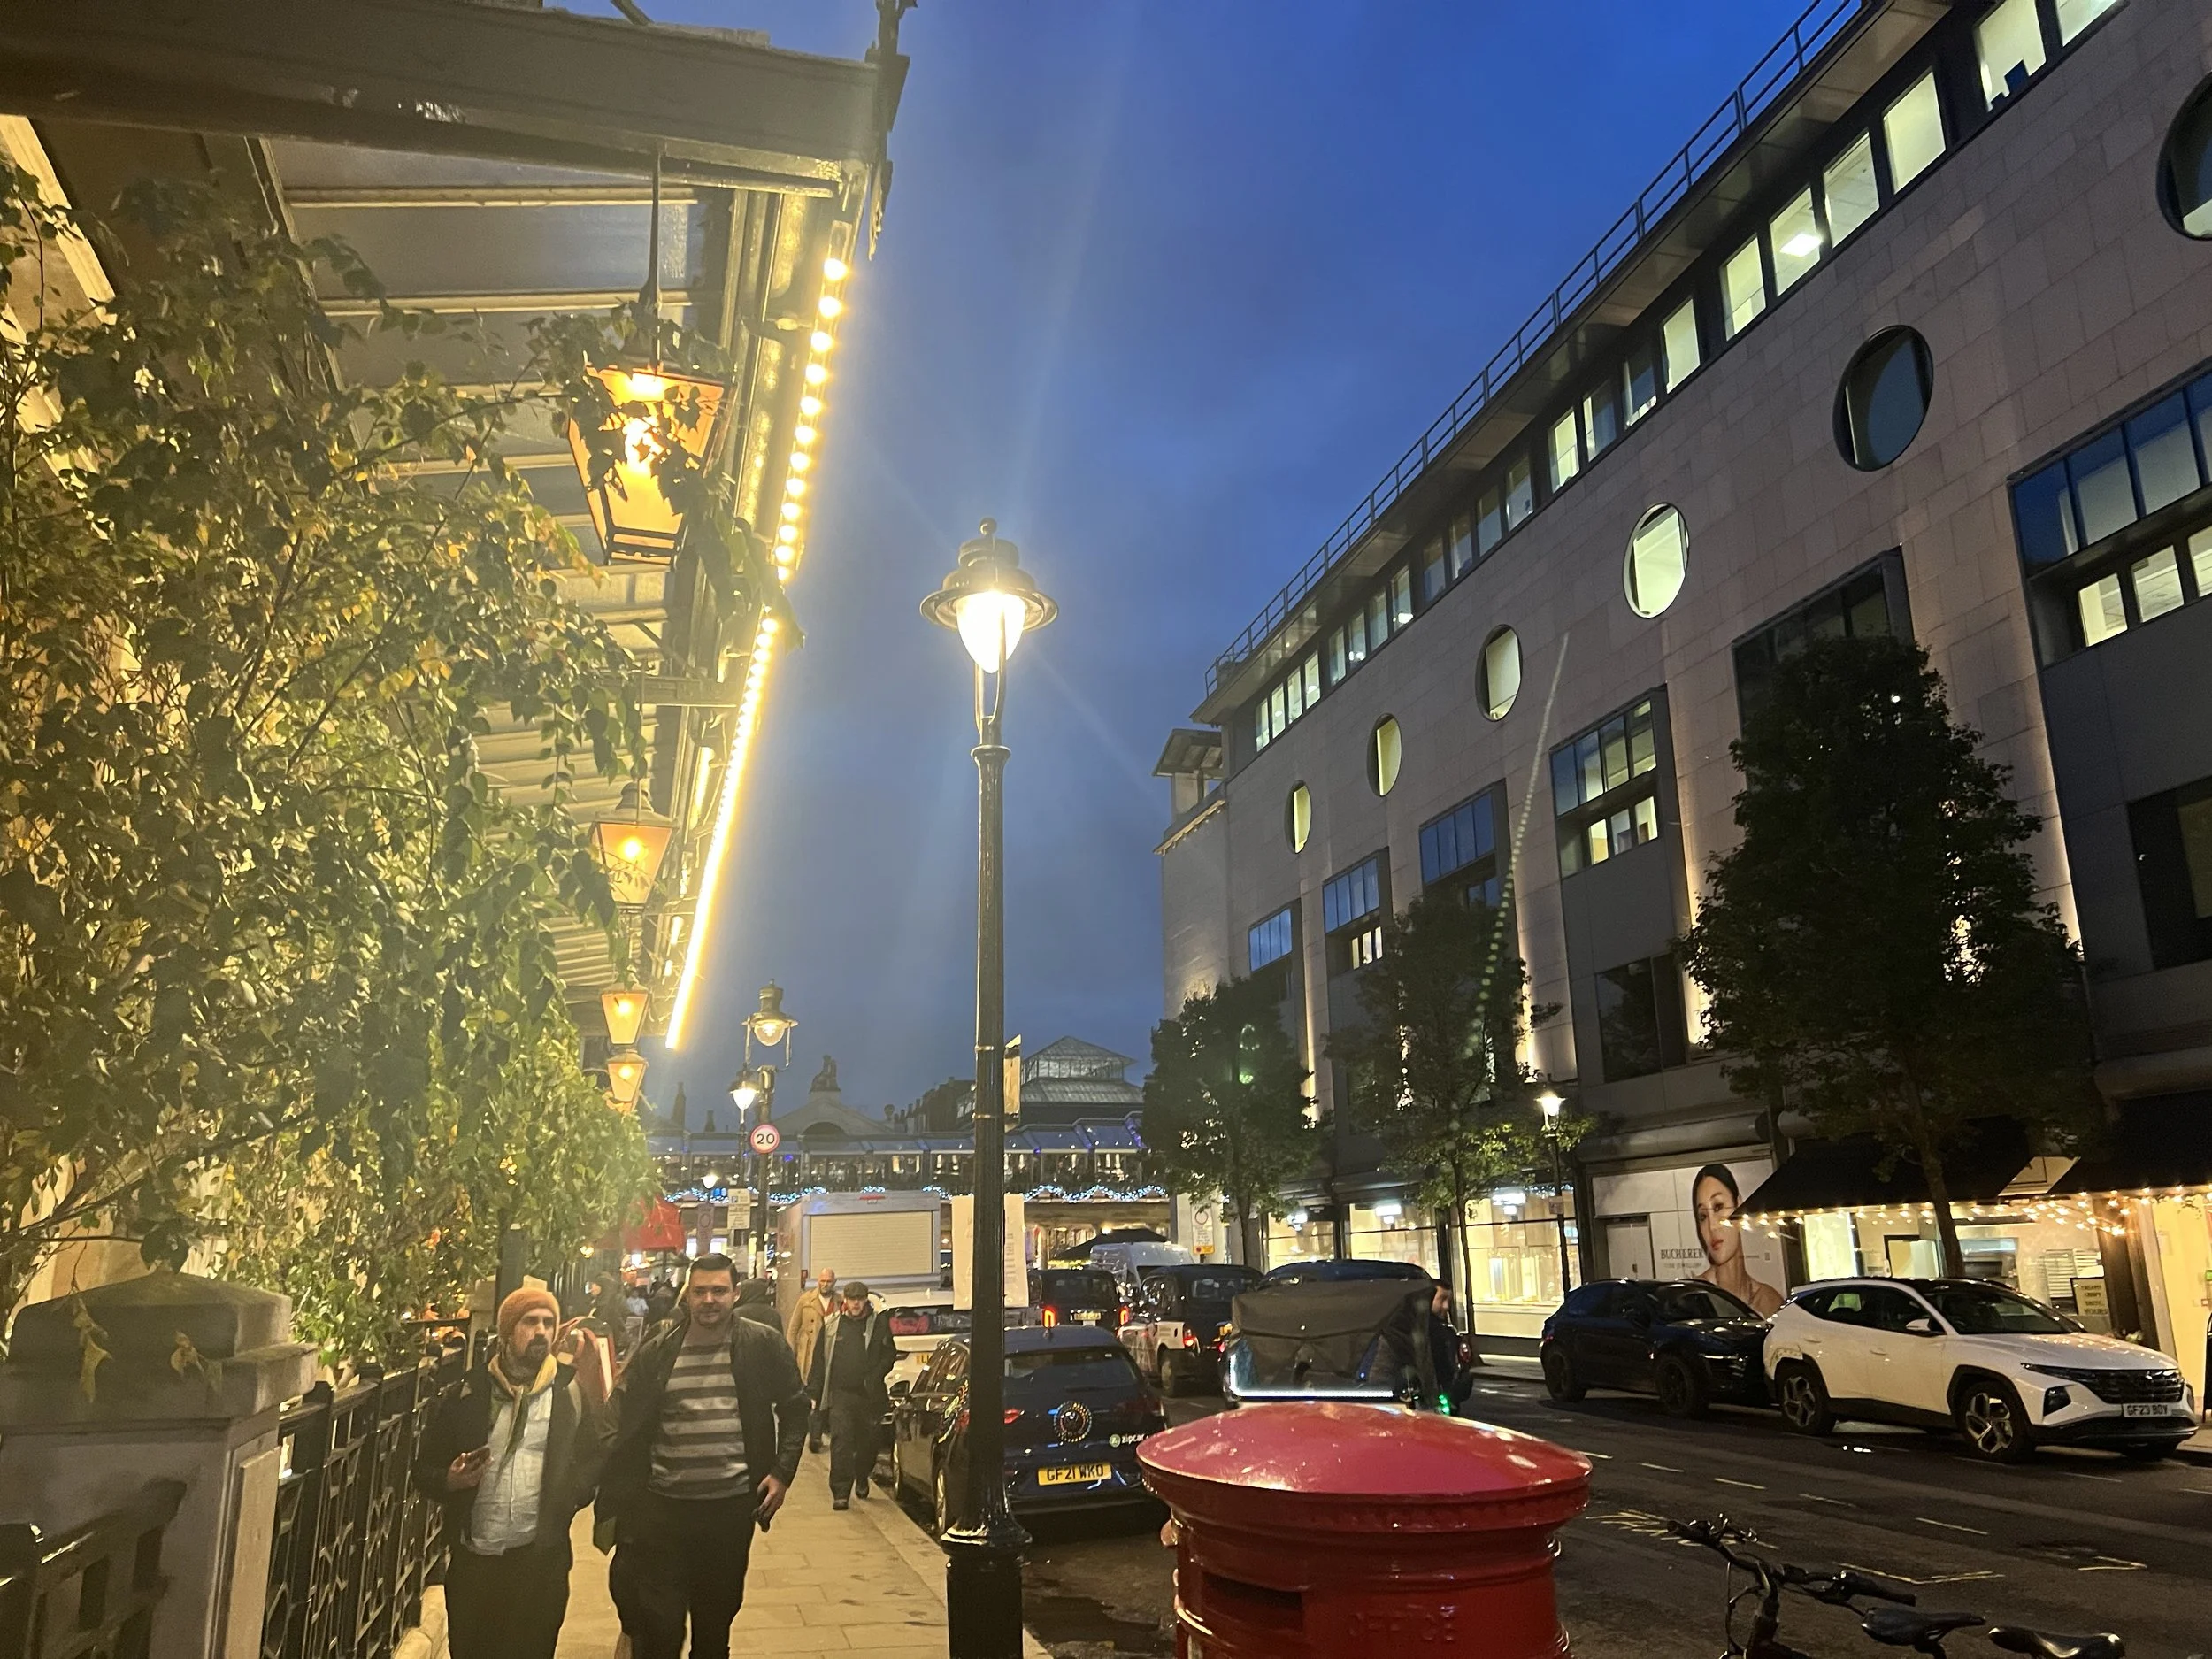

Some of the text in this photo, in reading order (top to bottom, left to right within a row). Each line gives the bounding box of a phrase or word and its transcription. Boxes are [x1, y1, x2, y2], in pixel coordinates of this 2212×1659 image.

[756, 1133, 775, 1145] 20
[1660, 1248, 1705, 1260] BUCHERER
[1121, 1433, 1146, 1445] zipcar
[1047, 1465, 1076, 1481] GF21
